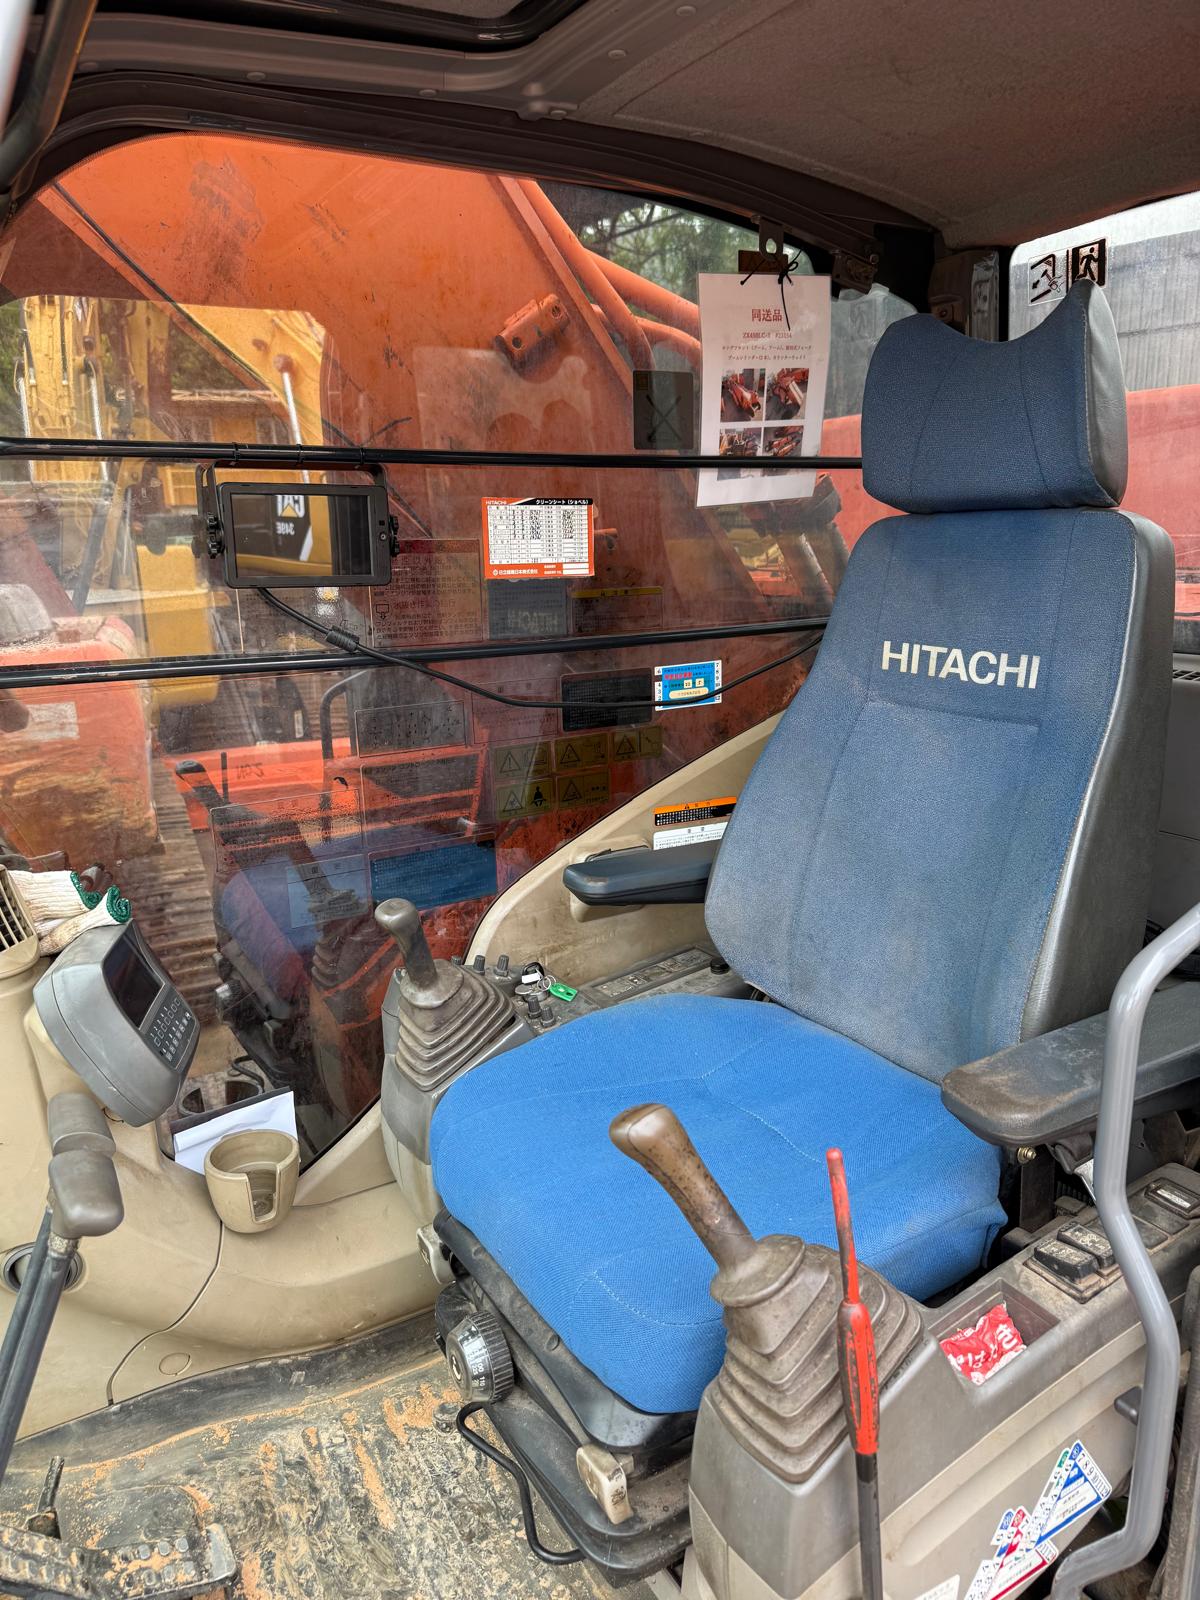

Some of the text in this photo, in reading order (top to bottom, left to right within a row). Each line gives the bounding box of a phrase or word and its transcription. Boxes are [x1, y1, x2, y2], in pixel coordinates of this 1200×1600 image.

[751, 308, 783, 322] 同送品
[881, 640, 1041, 689] HITACHI
